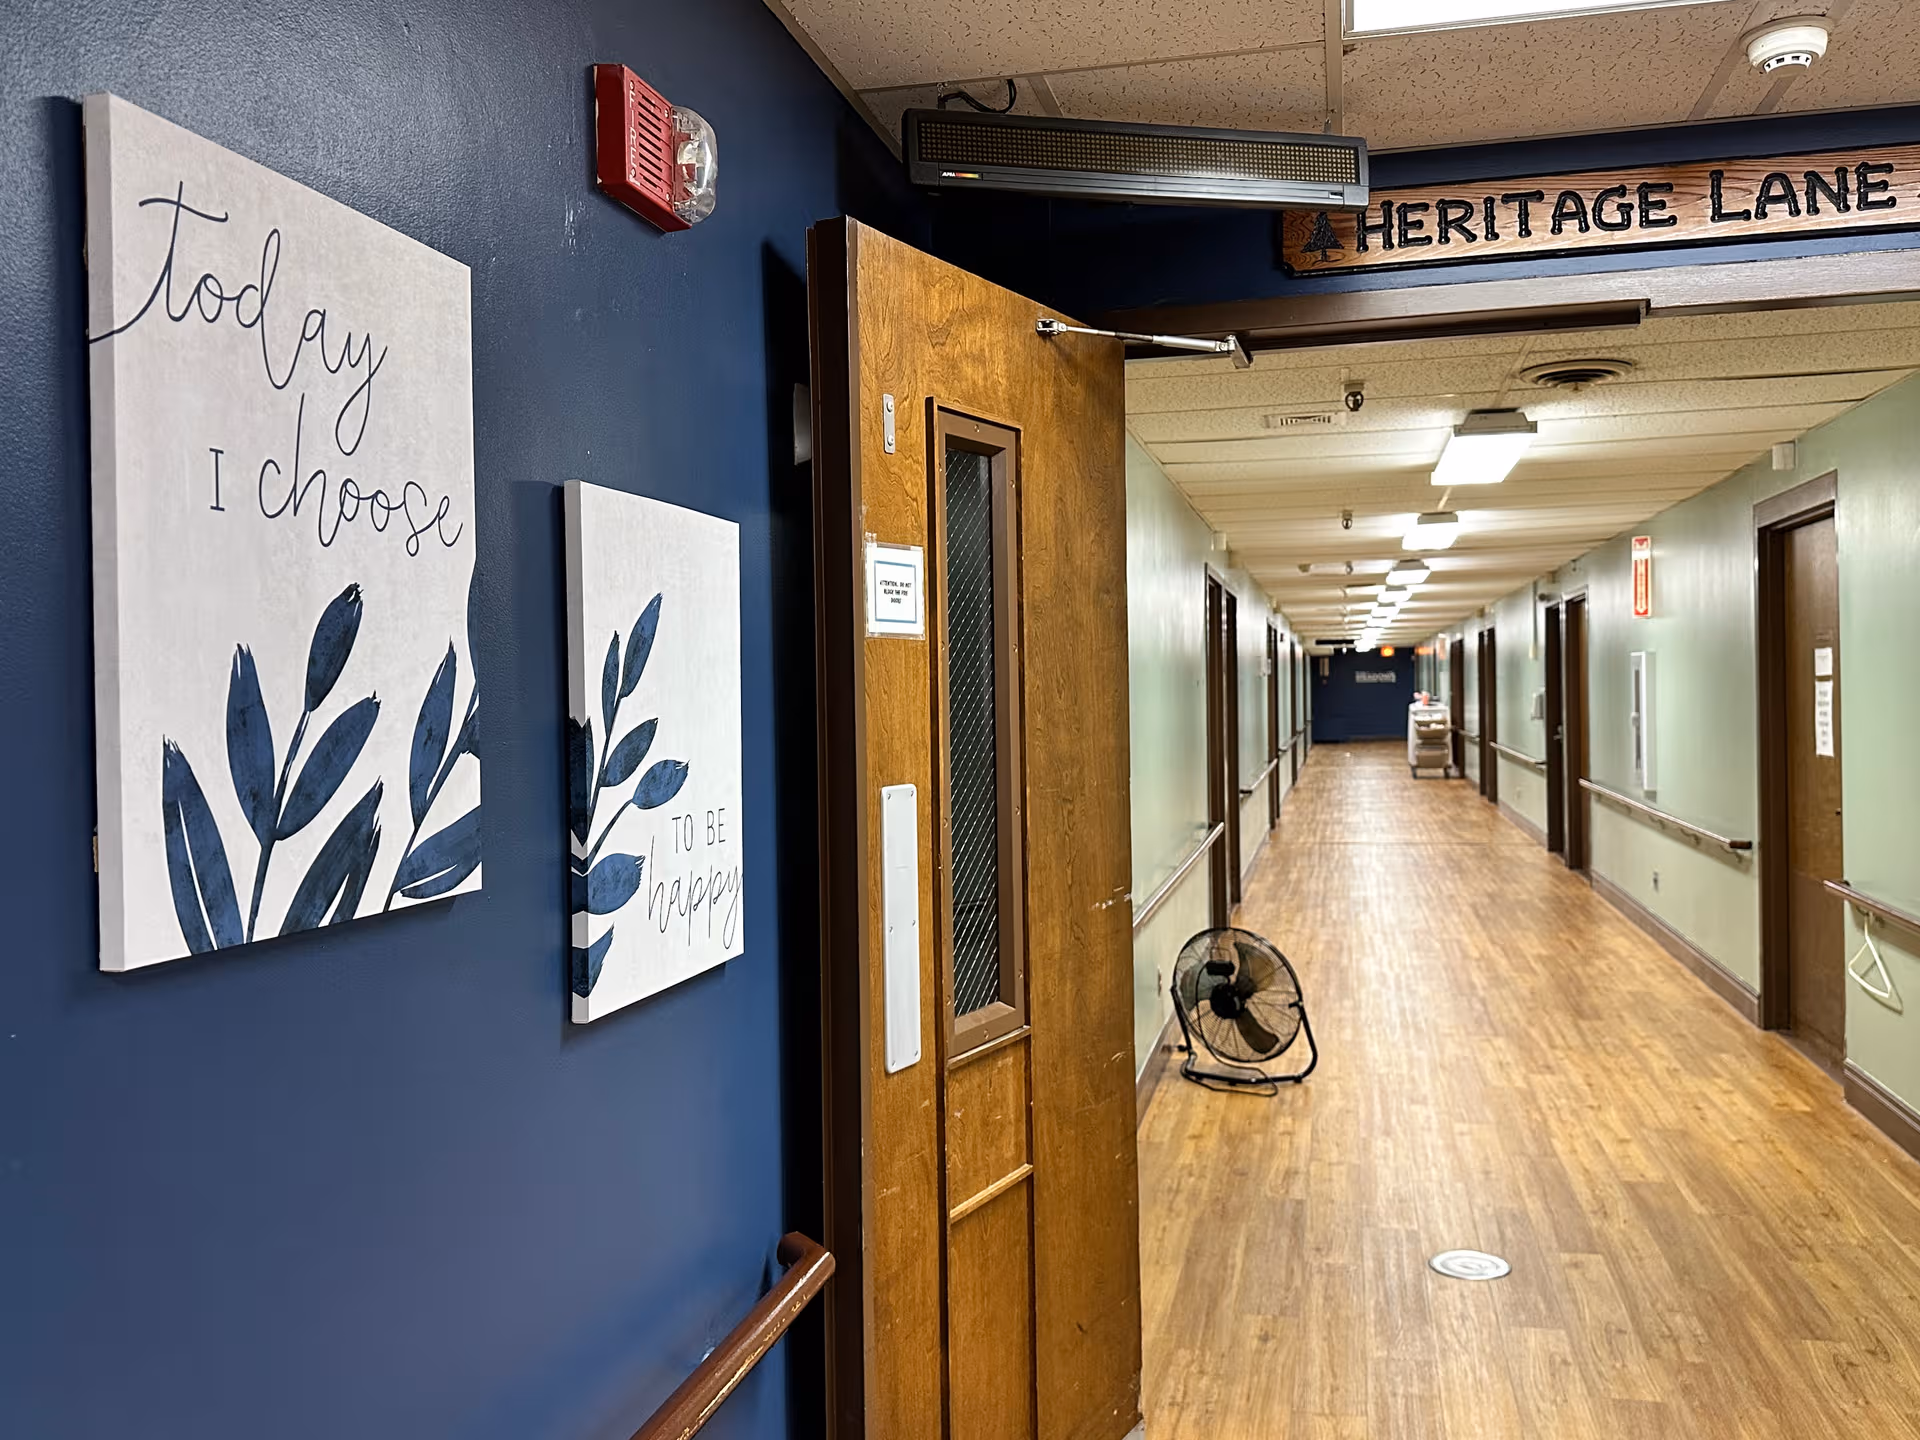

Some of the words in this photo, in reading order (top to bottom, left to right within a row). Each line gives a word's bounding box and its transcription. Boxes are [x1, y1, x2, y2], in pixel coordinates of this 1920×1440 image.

[629, 90, 637, 168] FIRE
[1355, 181, 1678, 253] HERITAGE
[1709, 161, 1898, 223] LANE
[89, 180, 388, 456] today
[209, 447, 226, 512] I
[258, 393, 464, 557] choose
[671, 814, 694, 854] TO
[706, 808, 726, 846] BE
[648, 835, 743, 950] happy
